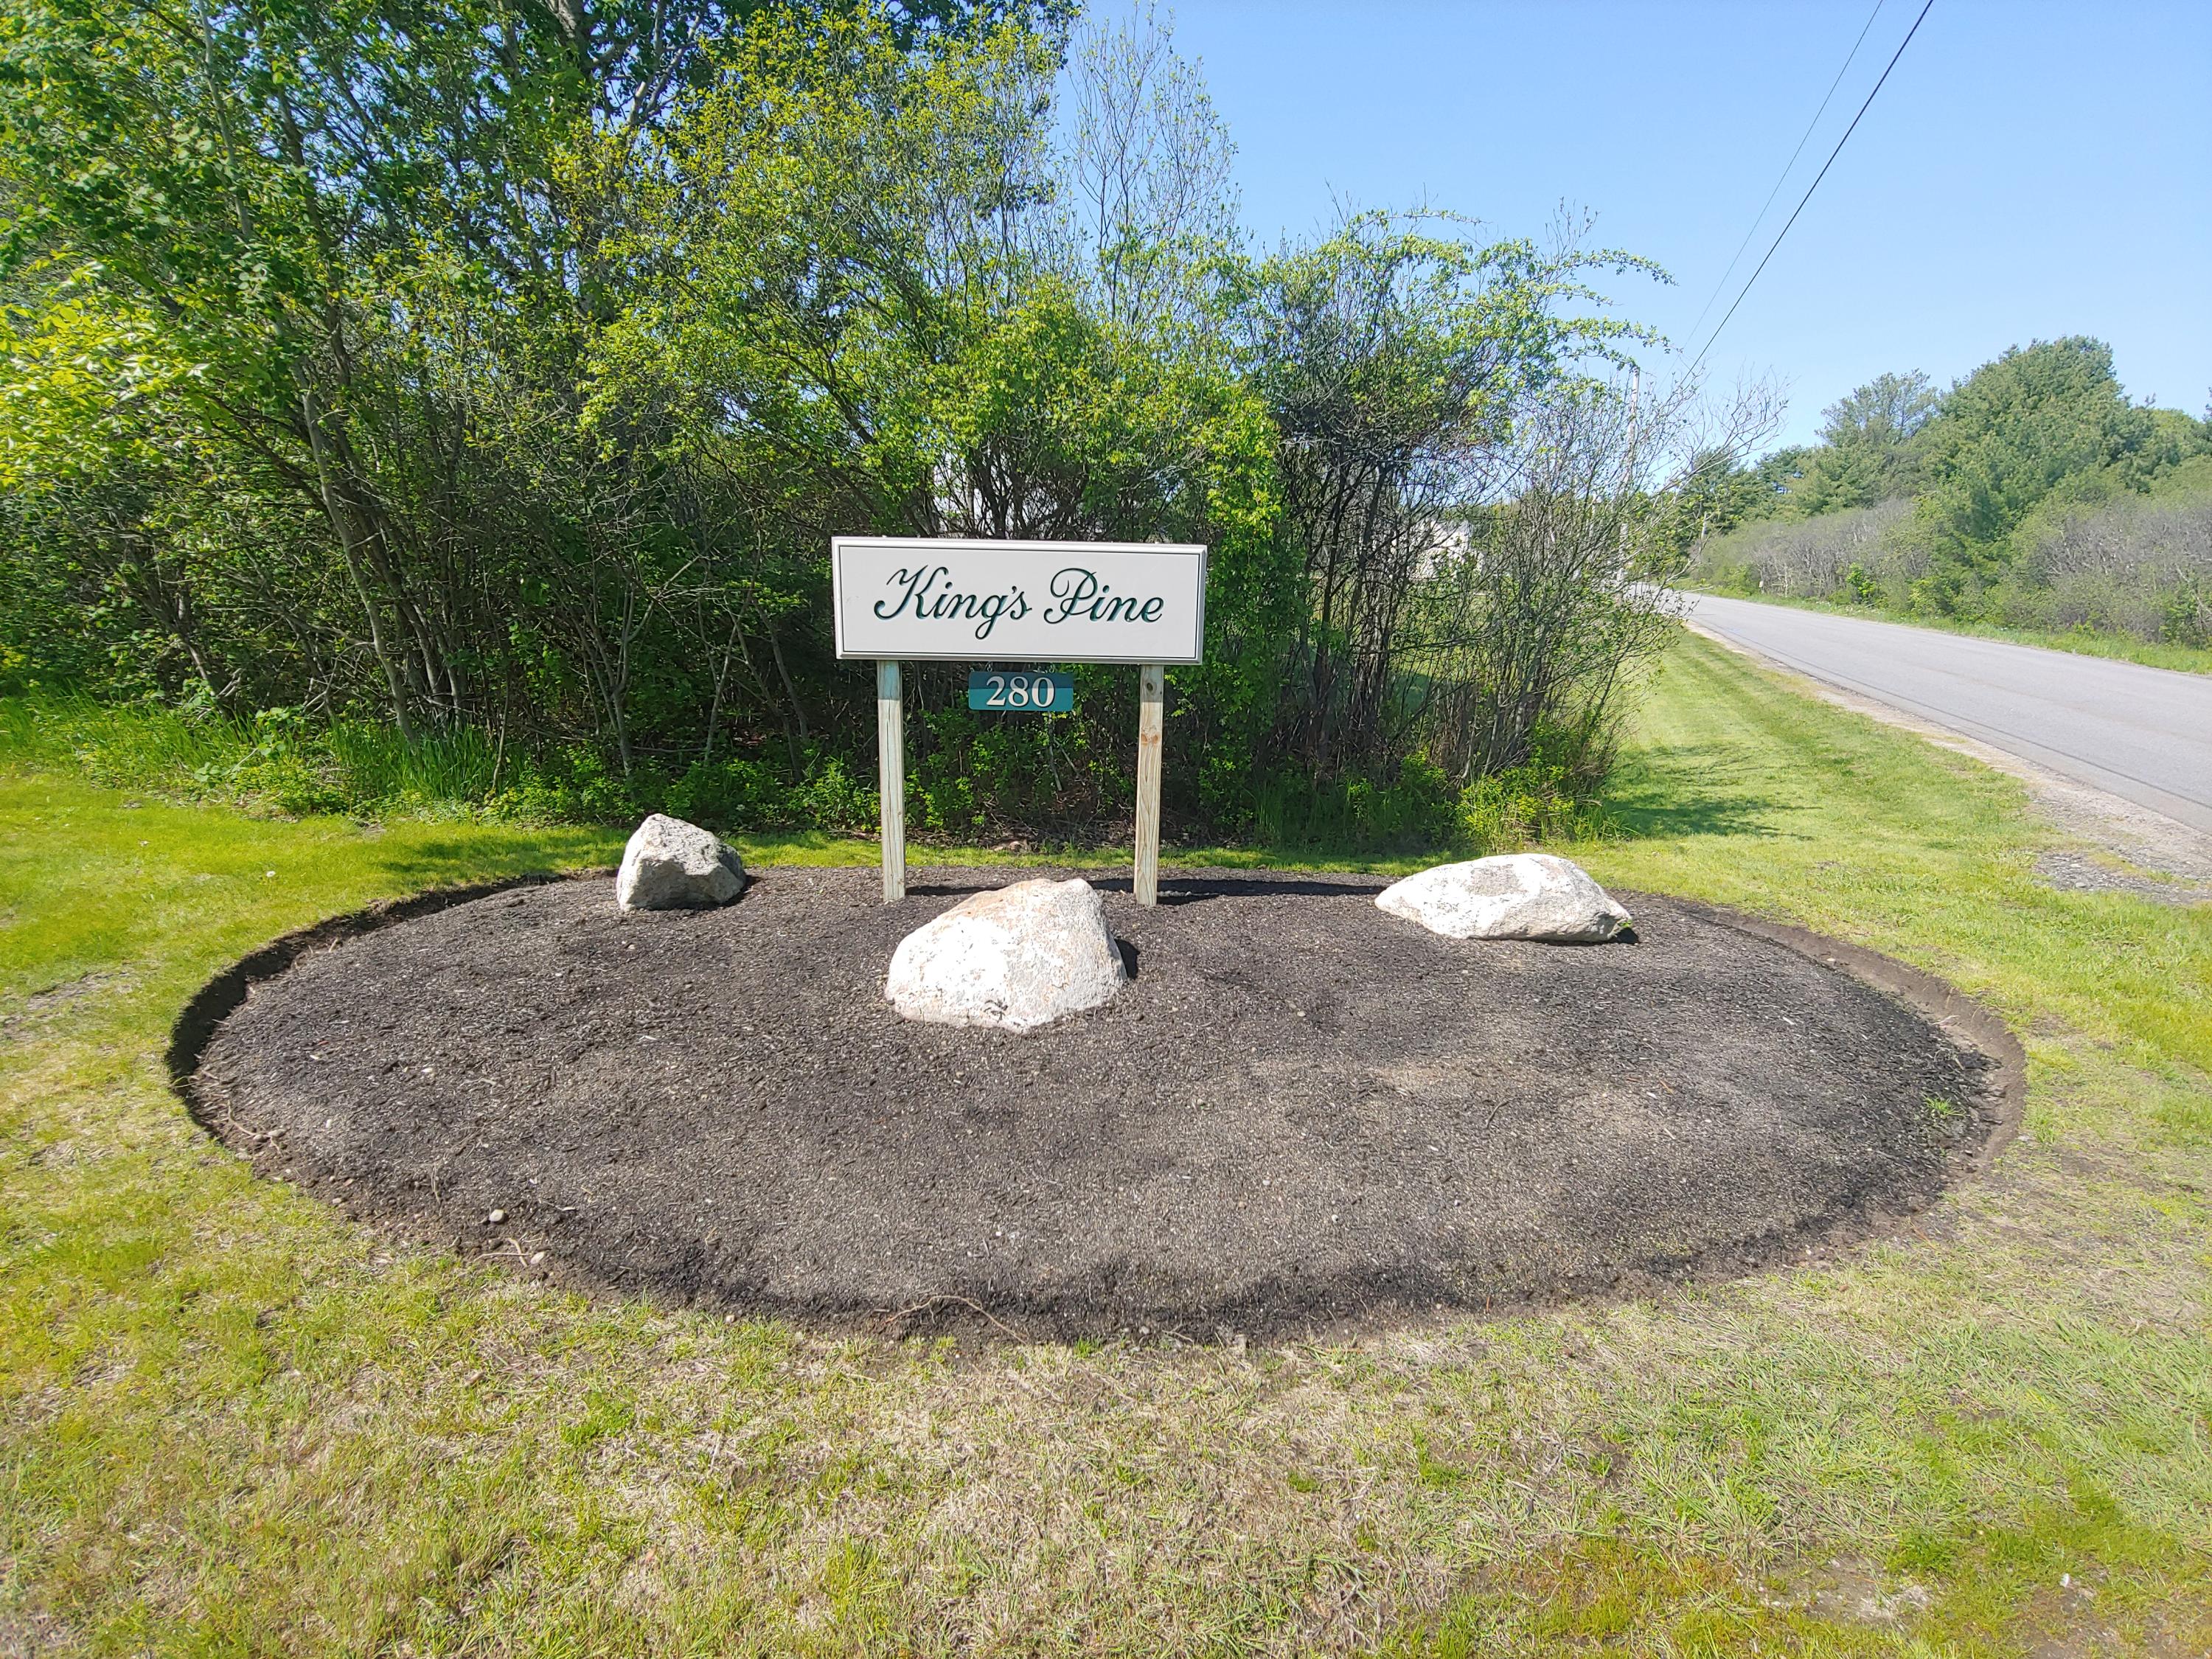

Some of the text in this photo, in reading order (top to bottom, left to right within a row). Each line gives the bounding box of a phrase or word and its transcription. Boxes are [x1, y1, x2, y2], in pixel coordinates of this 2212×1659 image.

[873, 564, 1164, 640] King's Pine
[985, 675, 1055, 708] 280
